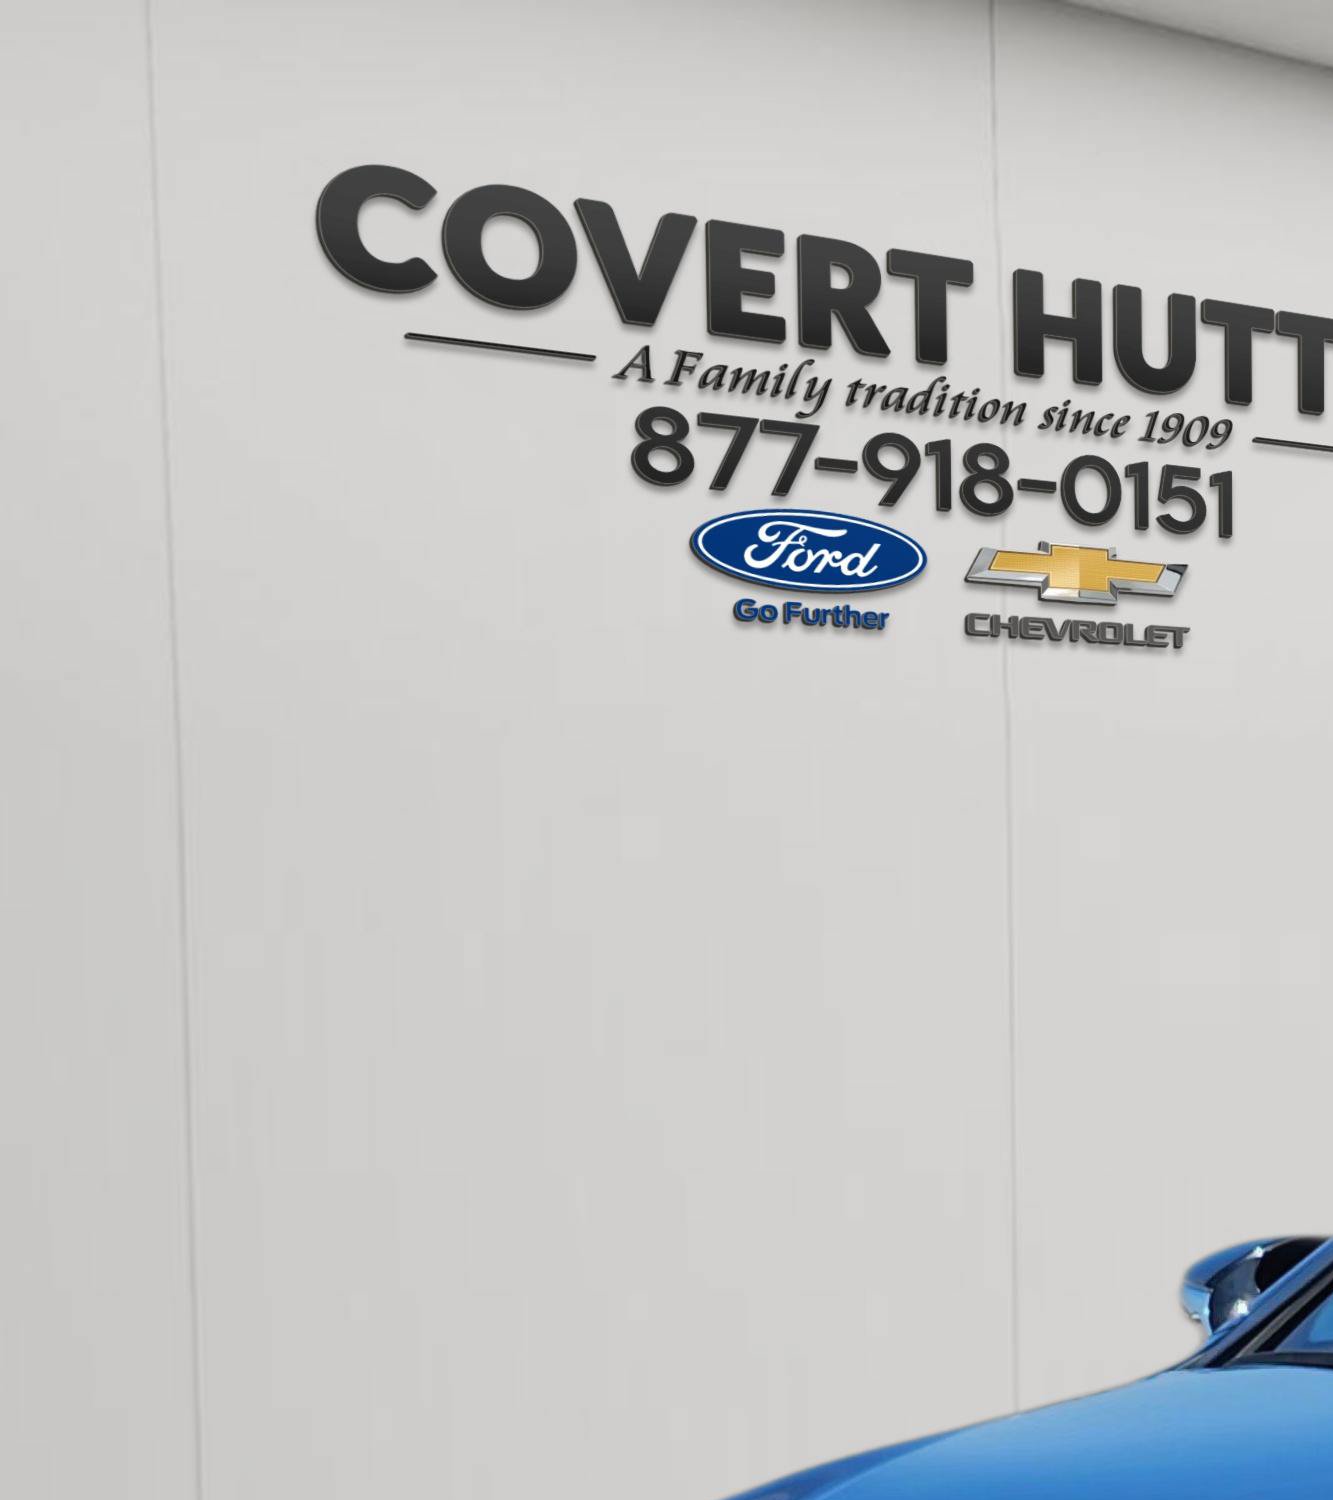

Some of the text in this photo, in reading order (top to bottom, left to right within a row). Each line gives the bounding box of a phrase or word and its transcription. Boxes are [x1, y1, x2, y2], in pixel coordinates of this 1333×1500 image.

[315, 164, 975, 366] COVERT
[611, 344, 1235, 451] A Family tradition since 1909
[629, 406, 1234, 541] 877-918-0151
[743, 520, 882, 579] Ford
[733, 598, 891, 632] Go Further
[964, 612, 1191, 650] CHEVROLET
